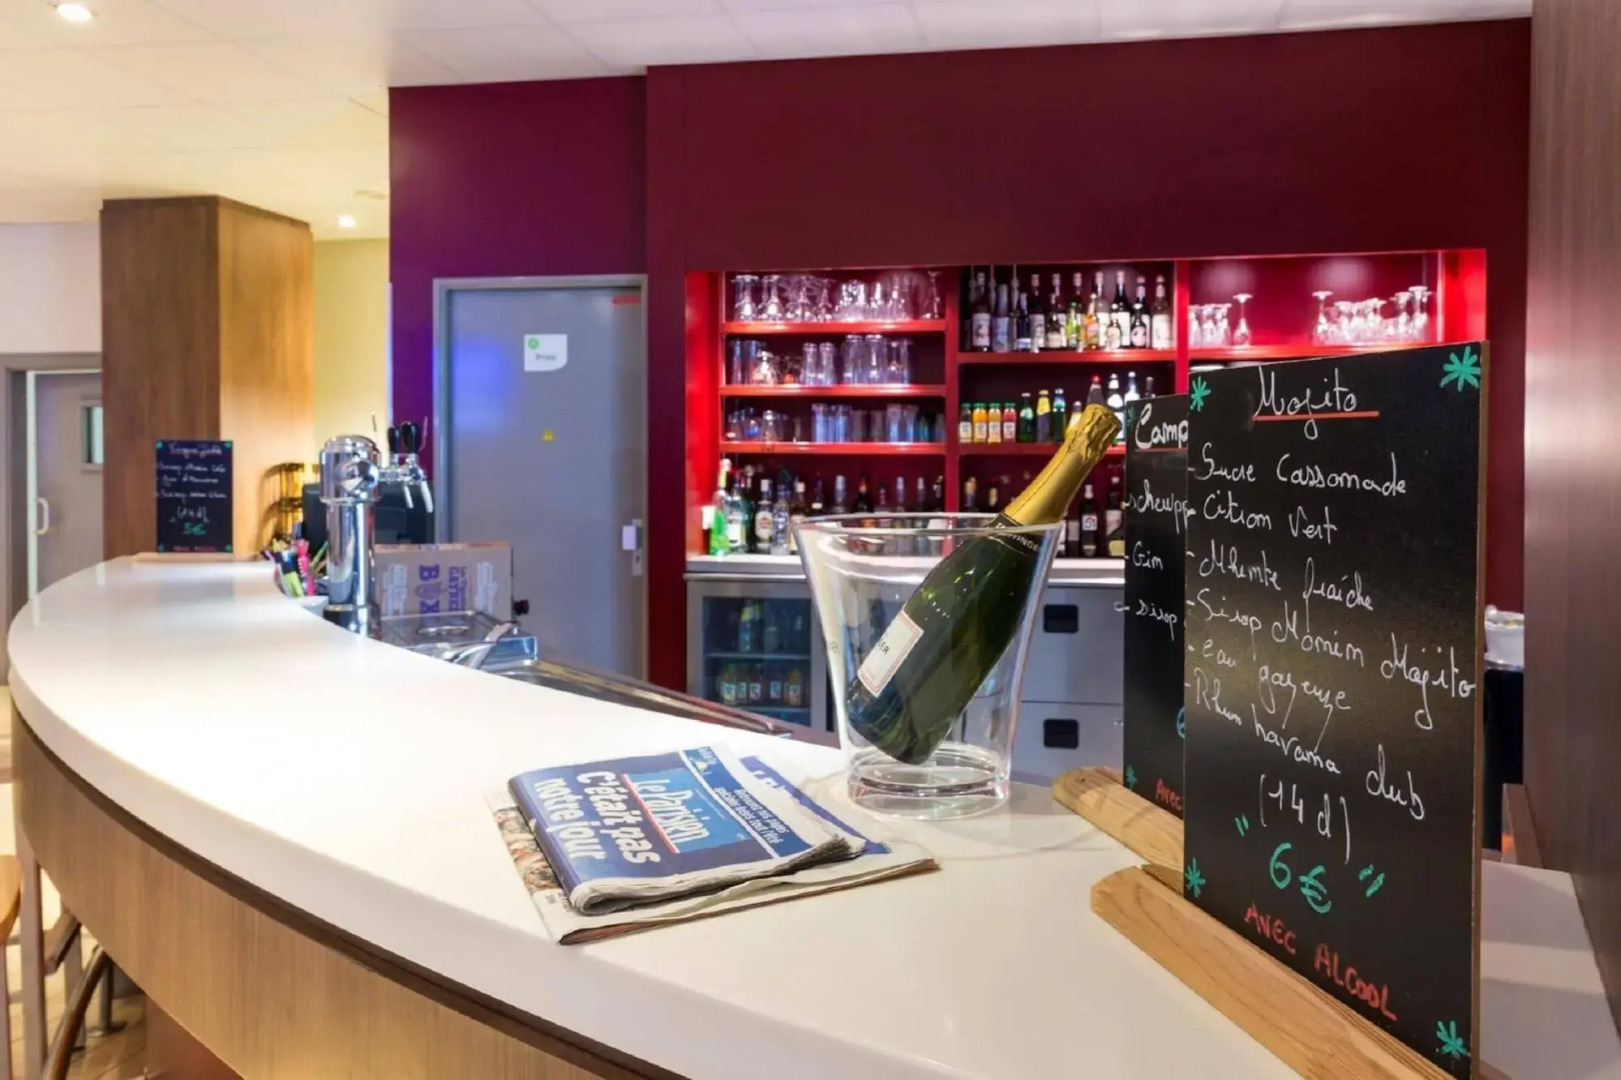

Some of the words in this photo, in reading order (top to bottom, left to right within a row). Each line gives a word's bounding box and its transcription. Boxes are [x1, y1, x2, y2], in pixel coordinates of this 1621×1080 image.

[1203, 489, 1273, 531] Citron
[1288, 505, 1338, 545] Vert
[1202, 638, 1237, 668] eau
[533, 777, 584, 822] notre
[576, 770, 643, 827] C'était
[639, 788, 711, 845] Parisien
[545, 820, 607, 860] jour
[599, 826, 662, 864] pas
[1313, 942, 1399, 1022] ALCOOL
